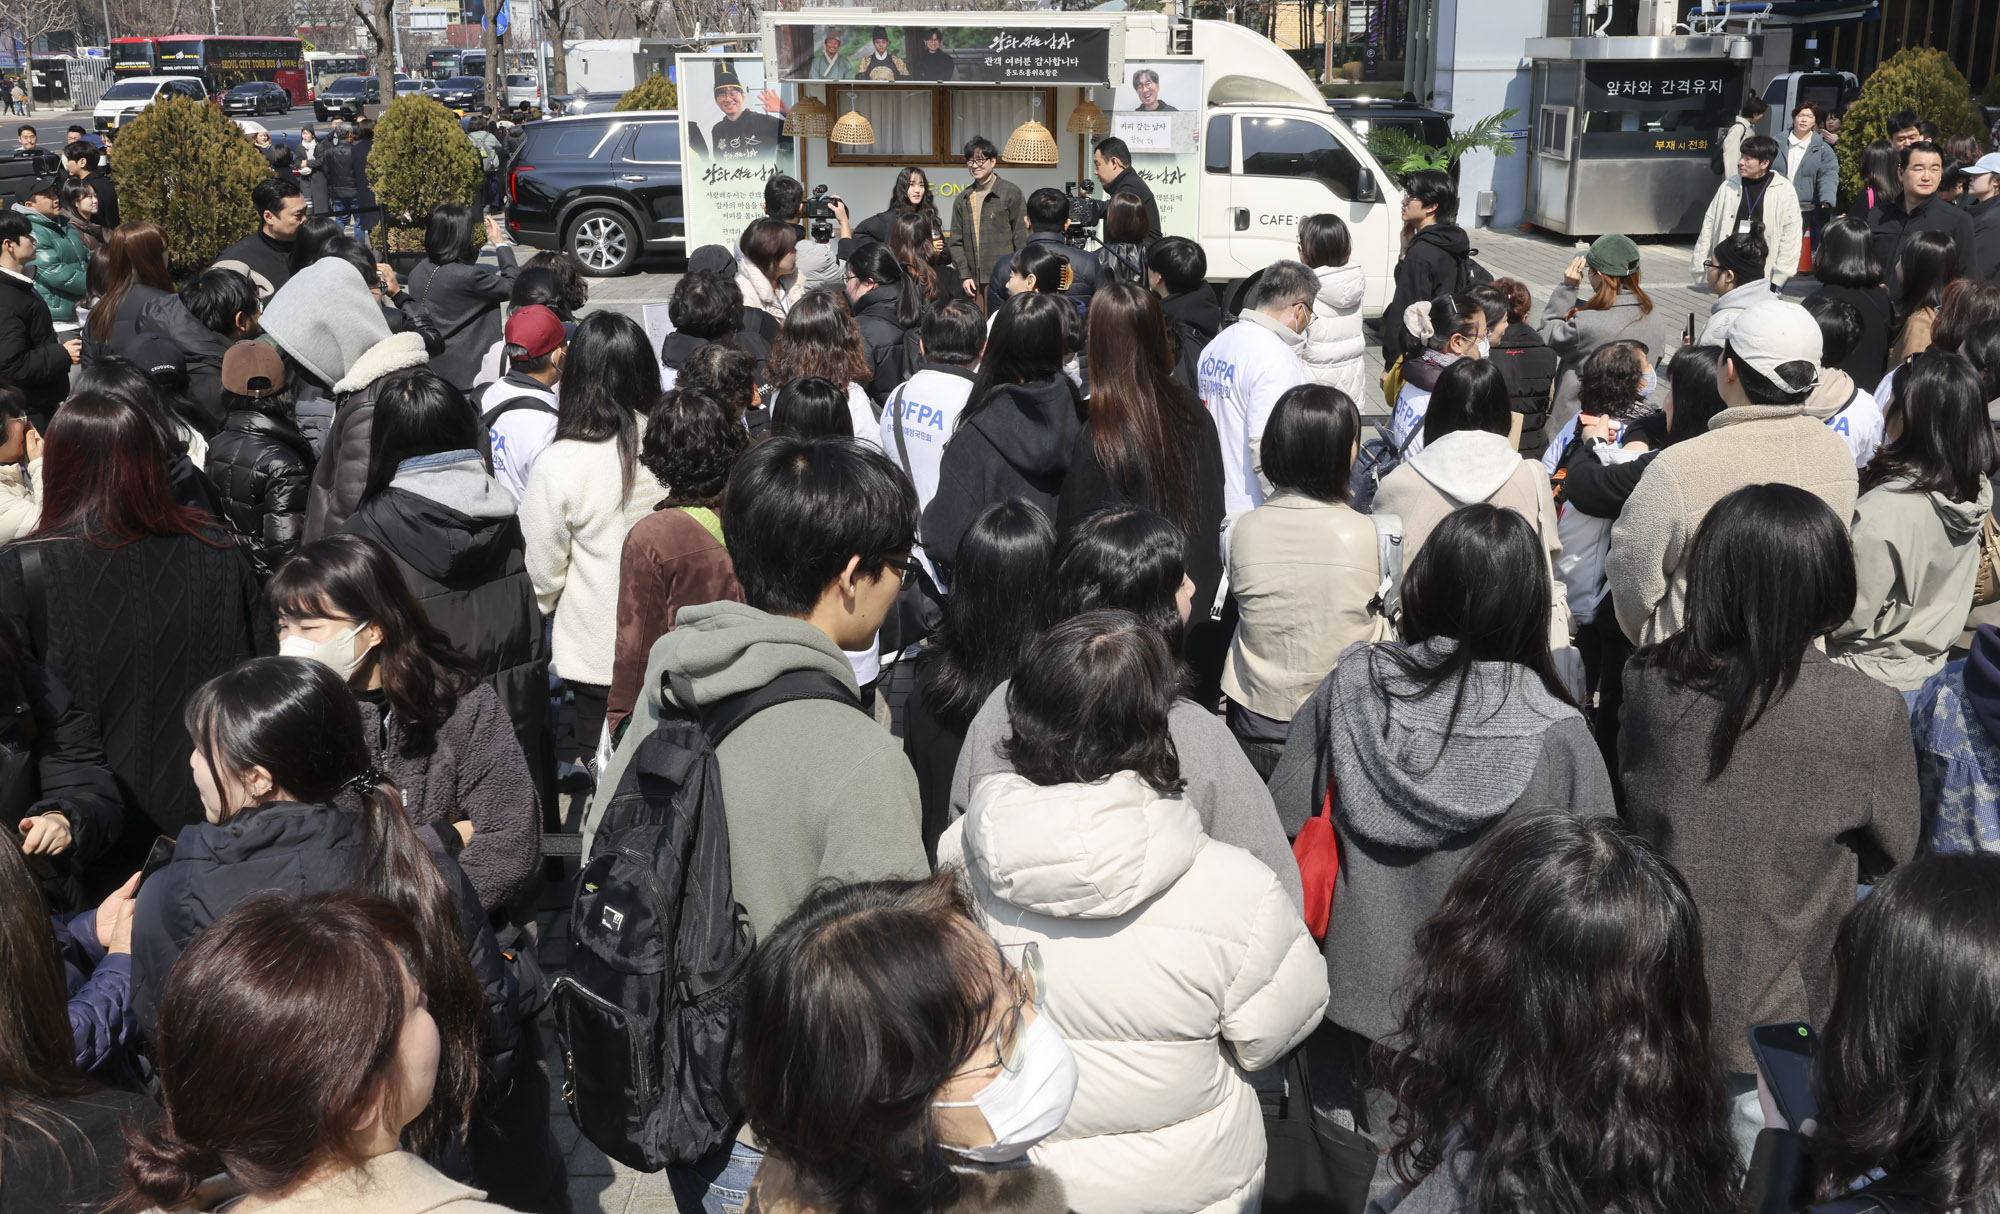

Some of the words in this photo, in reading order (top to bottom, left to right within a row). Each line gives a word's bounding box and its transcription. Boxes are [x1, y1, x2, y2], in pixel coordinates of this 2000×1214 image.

[988, 32, 1019, 53] 왕과
[1019, 34, 1043, 48] 사는
[1044, 32, 1075, 49] 남자
[221, 60, 238, 69] SEOUL
[239, 60, 251, 68] CITY
[252, 60, 265, 68] TOUR
[266, 59, 275, 68] BUS
[984, 57, 1002, 66] 관객
[1005, 57, 1032, 67] 여러분
[1034, 57, 1079, 67] 감사합니다
[1606, 80, 1653, 97] 앞차와
[1660, 79, 1724, 96] 간격유지
[1120, 122, 1134, 130] 커피
[1152, 122, 1167, 131] 남자
[1655, 140, 1675, 151] 부재
[1677, 142, 1686, 150] 시
[1687, 140, 1708, 150] 전화
[702, 164, 730, 186] 왕과
[730, 167, 753, 181] 사는
[1156, 166, 1187, 184] 남자
[706, 191, 747, 200] 사랑해주시는
[748, 191, 765, 199] 관객
[716, 202, 736, 210] 감사의
[737, 202, 758, 210] 마음을
[1159, 204, 1174, 213] 담아
[723, 212, 742, 220] 커피를
[1260, 214, 1299, 226] CAFE:
[1200, 352, 1235, 385] KOFPA
[1396, 396, 1423, 428] OFPA
